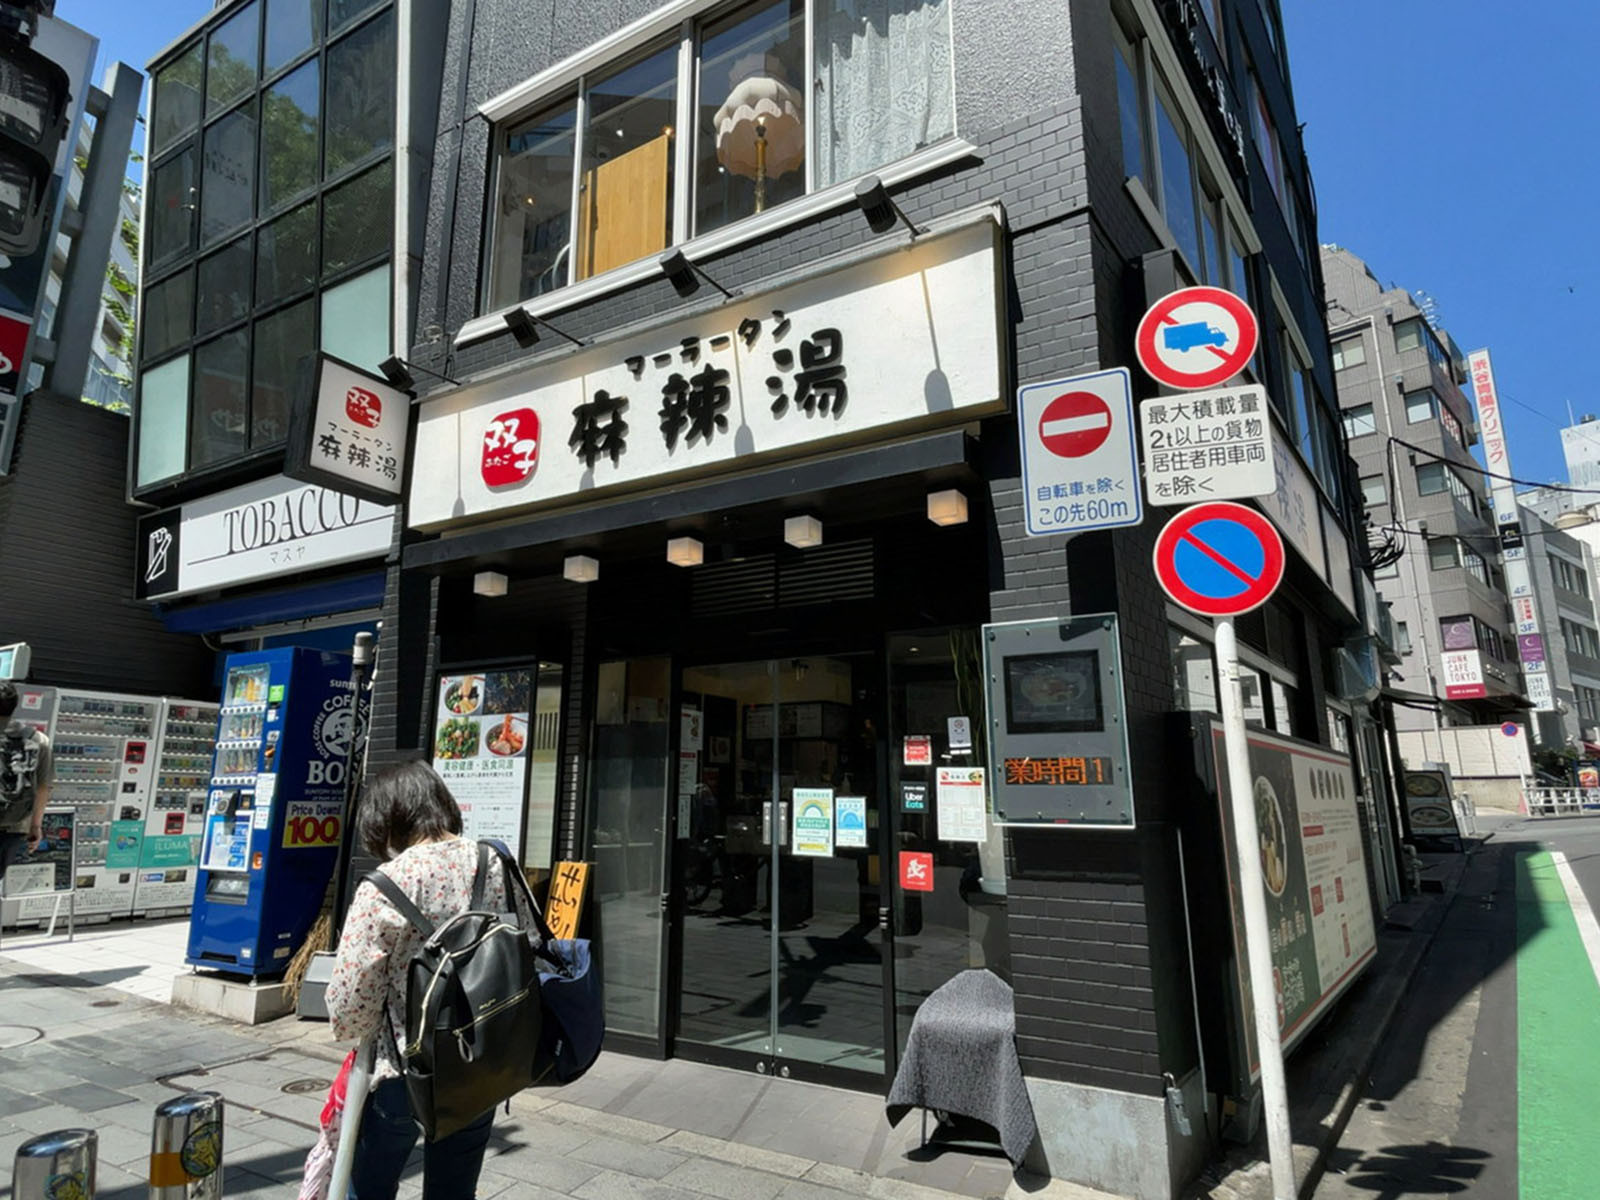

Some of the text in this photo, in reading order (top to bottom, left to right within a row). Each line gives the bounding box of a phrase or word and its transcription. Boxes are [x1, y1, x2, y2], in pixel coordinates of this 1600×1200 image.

[624, 308, 792, 376] マーラータン
[568, 327, 850, 470] 麻辣湯
[1147, 392, 1260, 425] 最大積載量
[328, 421, 392, 452] マーラータン
[484, 417, 536, 475] 双子
[1150, 418, 1263, 449] 2t以上の貨物
[318, 434, 397, 481] 麻辣湯
[1152, 444, 1266, 473] 居住者用車両
[1037, 477, 1125, 501] 自転車を除く
[1154, 475, 1215, 498] を除く
[224, 487, 360, 555] TOBACCO
[1039, 498, 1129, 526] この先60m
[269, 545, 306, 564] マスヤ
[1520, 622, 1536, 633] 3F
[291, 804, 313, 816] Price
[904, 792, 924, 801] Uber
[288, 815, 340, 845] 100
